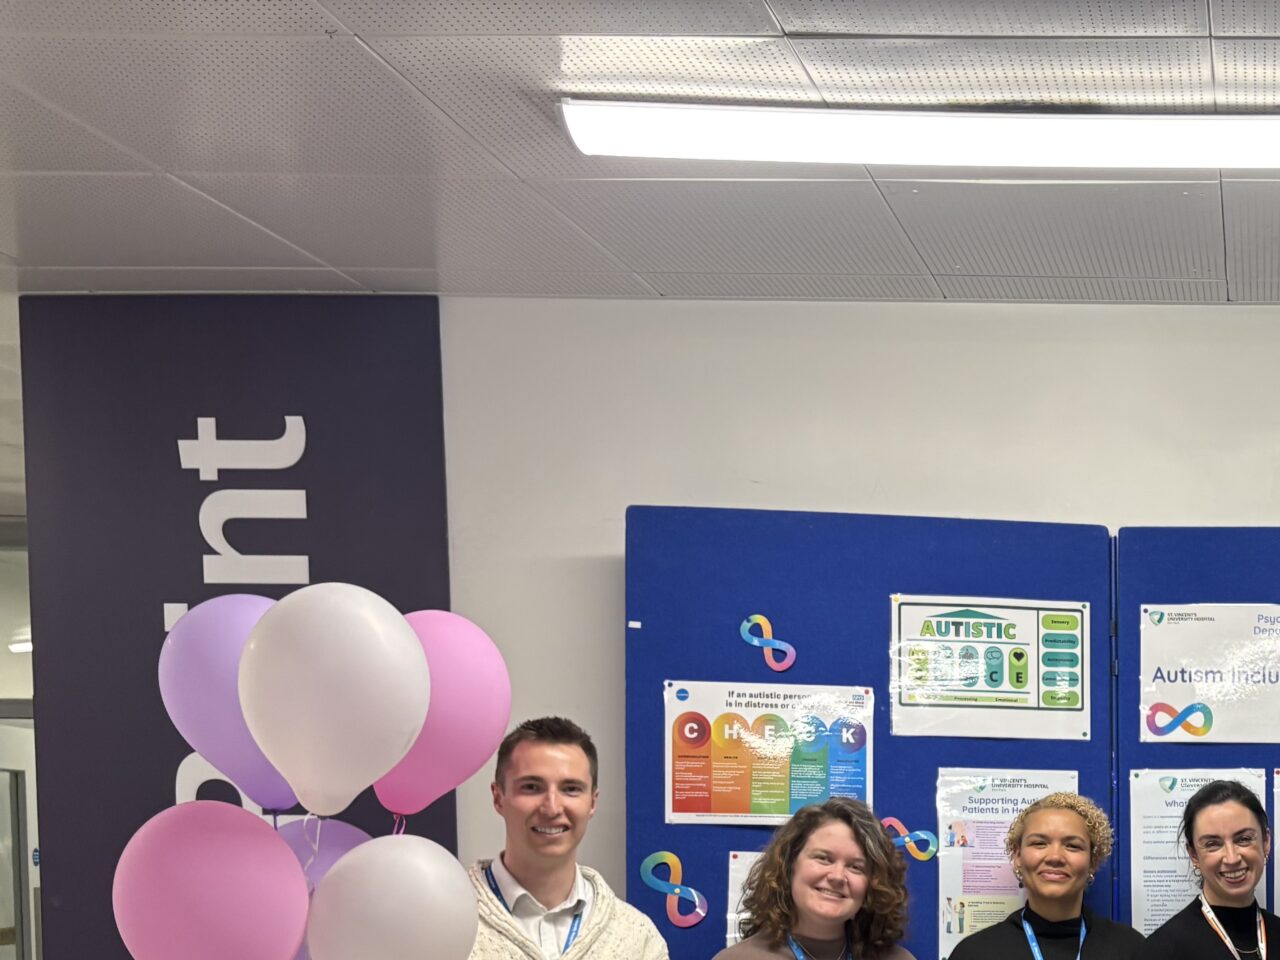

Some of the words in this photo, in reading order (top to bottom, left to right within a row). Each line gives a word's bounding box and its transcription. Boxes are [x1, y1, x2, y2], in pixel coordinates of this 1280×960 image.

[920, 619, 1017, 640] AUTISTIC
[989, 671, 998, 683] C
[1015, 672, 1023, 683] E
[1152, 666, 1223, 684] Autism
[728, 690, 735, 698] If
[749, 691, 781, 700] autistic
[726, 700, 733, 708] is
[734, 700, 743, 708] in
[745, 700, 778, 709] distress
[684, 722, 698, 739] C
[842, 727, 855, 744] K
[968, 796, 1019, 806] Supporting
[962, 806, 999, 814] Patients
